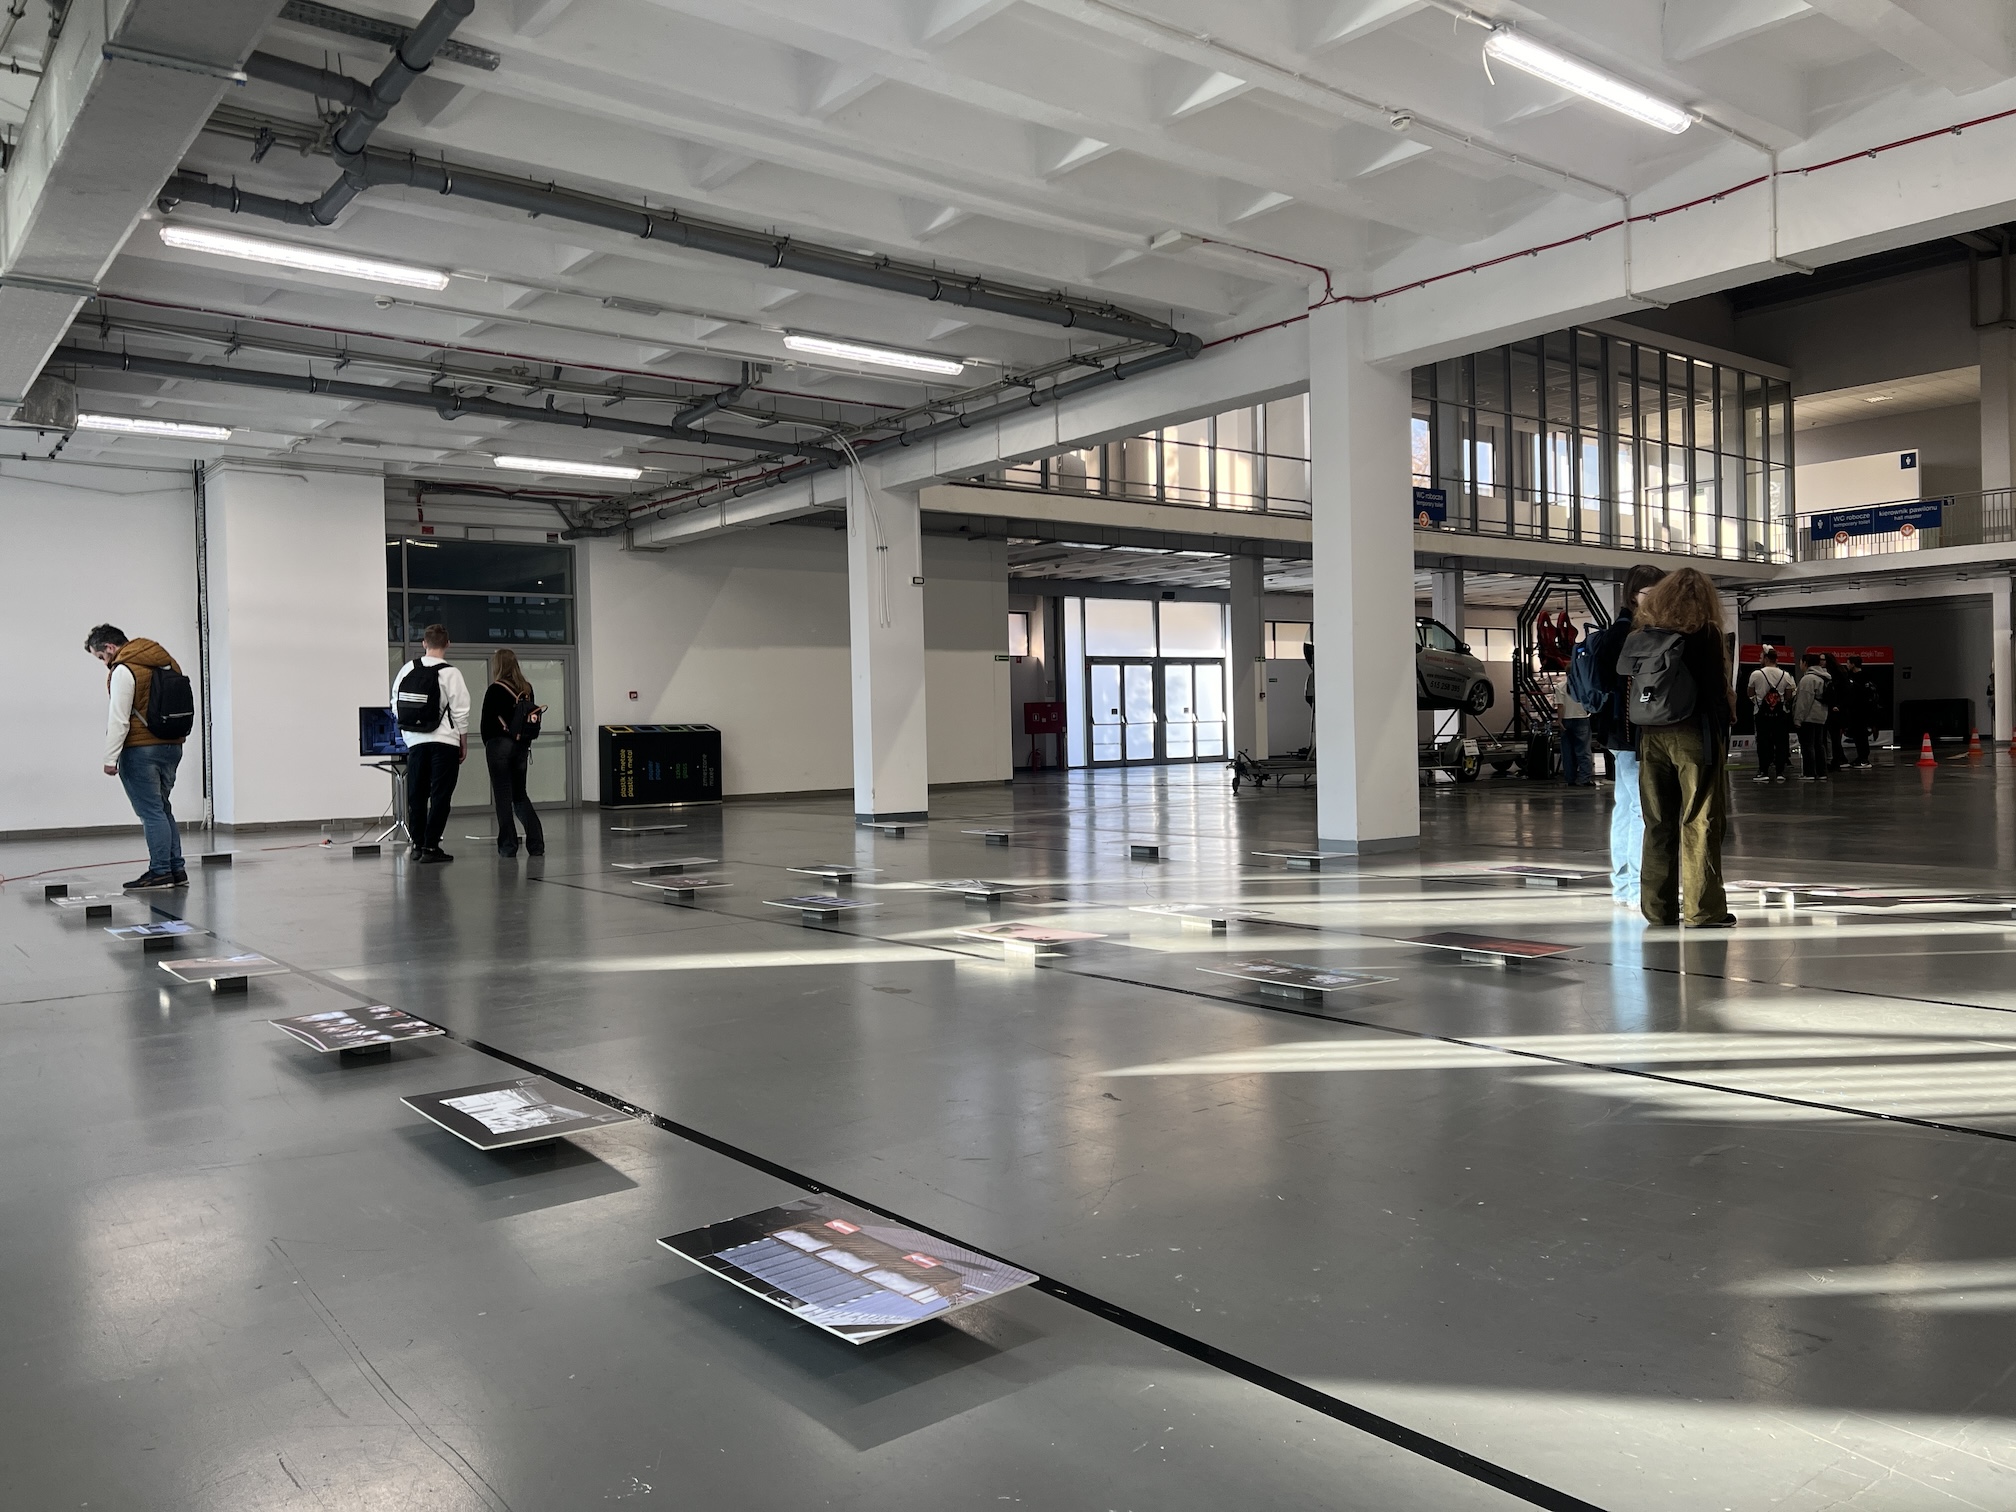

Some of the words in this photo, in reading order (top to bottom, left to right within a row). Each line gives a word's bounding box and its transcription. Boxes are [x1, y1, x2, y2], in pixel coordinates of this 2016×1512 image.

[1878, 508, 1908, 517] kierownik
[1909, 505, 1937, 514] pawilonu
[1846, 512, 1871, 521] robocze
